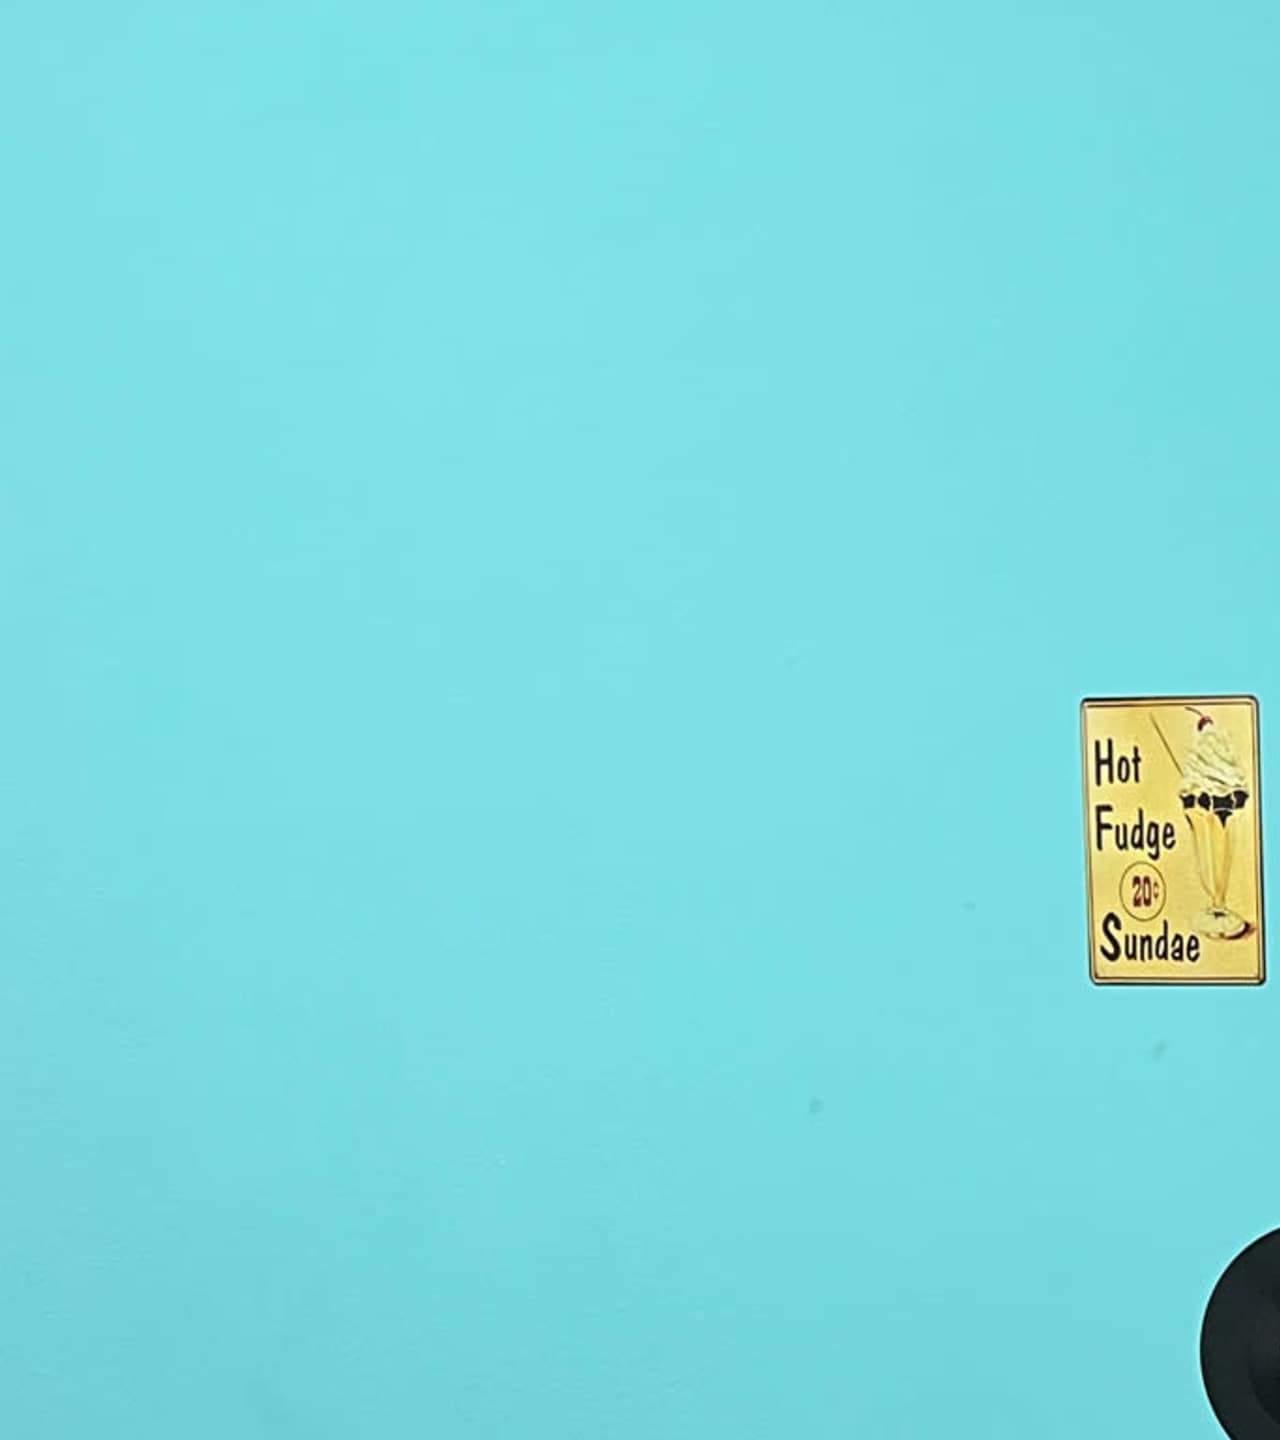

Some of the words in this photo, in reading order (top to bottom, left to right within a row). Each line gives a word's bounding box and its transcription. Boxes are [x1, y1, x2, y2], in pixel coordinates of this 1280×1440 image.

[1095, 738, 1142, 787] Hot
[1095, 804, 1176, 860] Fudge
[1100, 911, 1200, 962] Sundae
